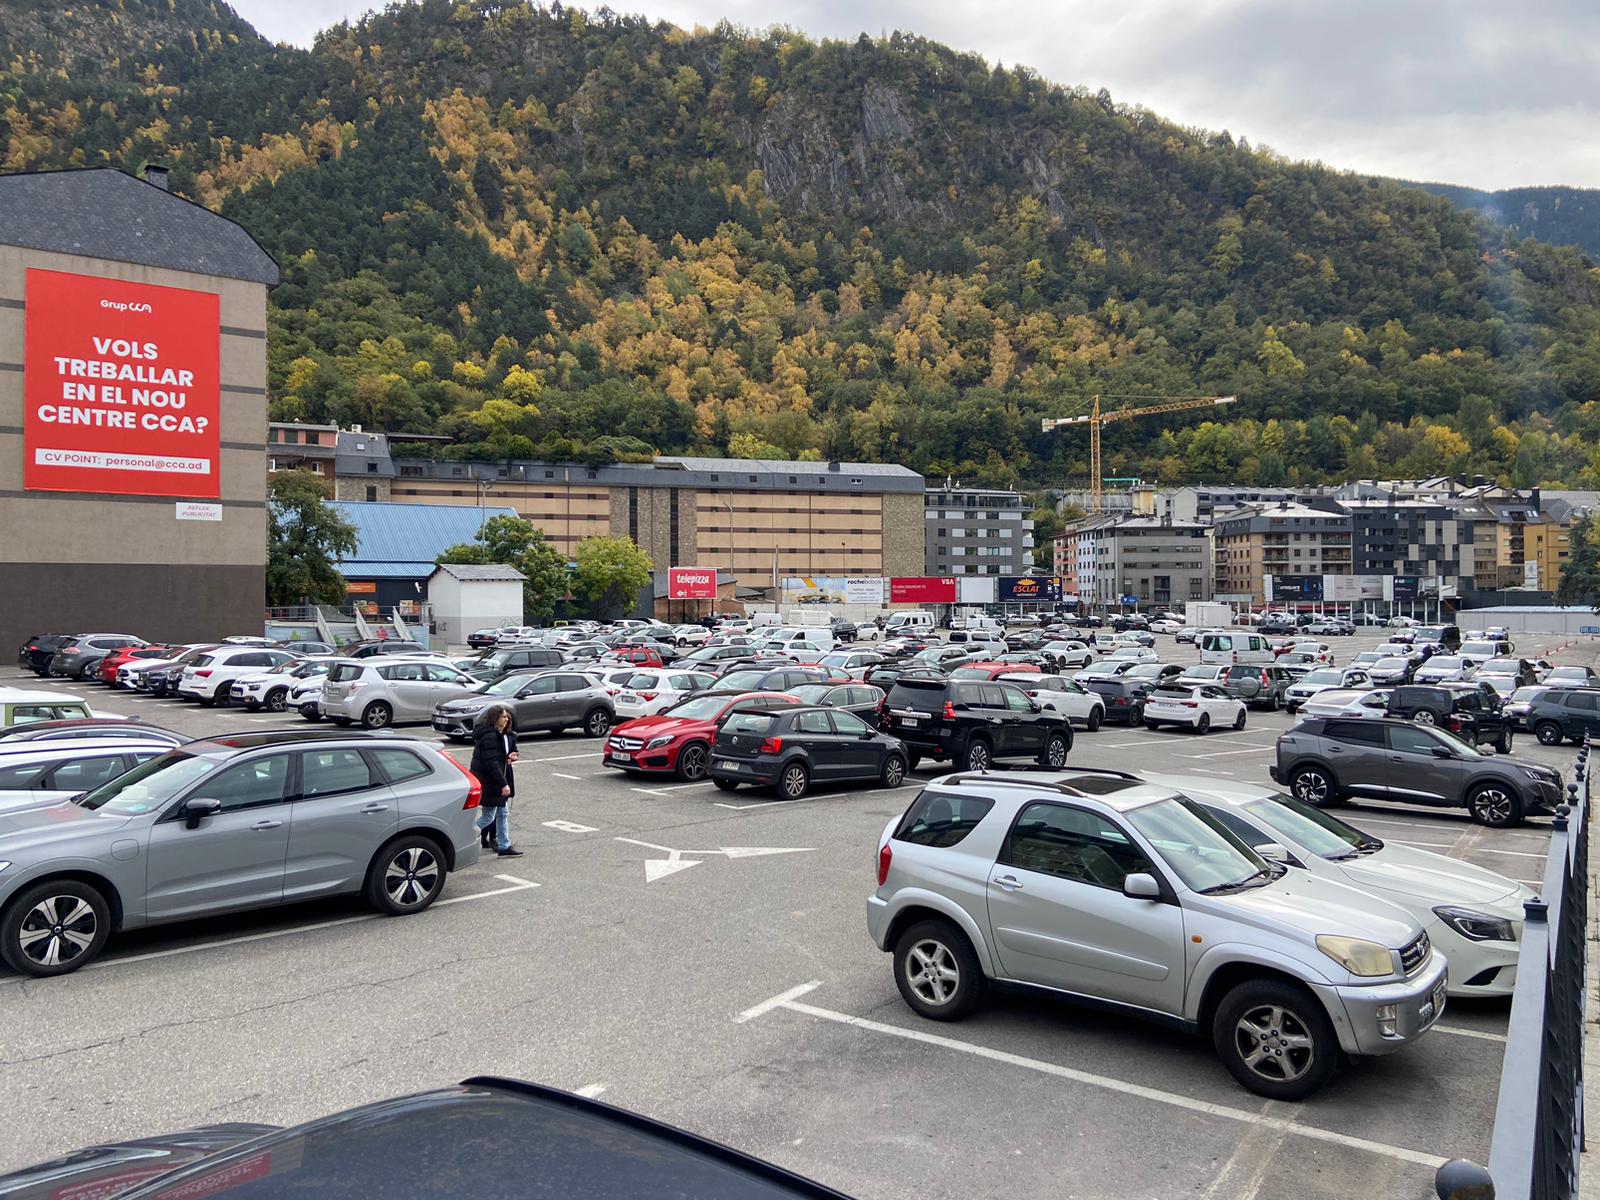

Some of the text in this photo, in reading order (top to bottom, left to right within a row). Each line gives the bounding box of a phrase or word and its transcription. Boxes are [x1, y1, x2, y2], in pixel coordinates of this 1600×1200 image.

[100, 299, 128, 312] Grup
[92, 336, 159, 360] VOLS
[54, 356, 194, 387] TREBALLAR
[63, 381, 186, 409] EN EL NOU
[37, 404, 208, 434] CENTRE CCA?
[44, 452, 203, 470] CV POINT: personal@cca.ad
[676, 573, 710, 588] telepizza
[1012, 585, 1040, 593] ESCLAT
